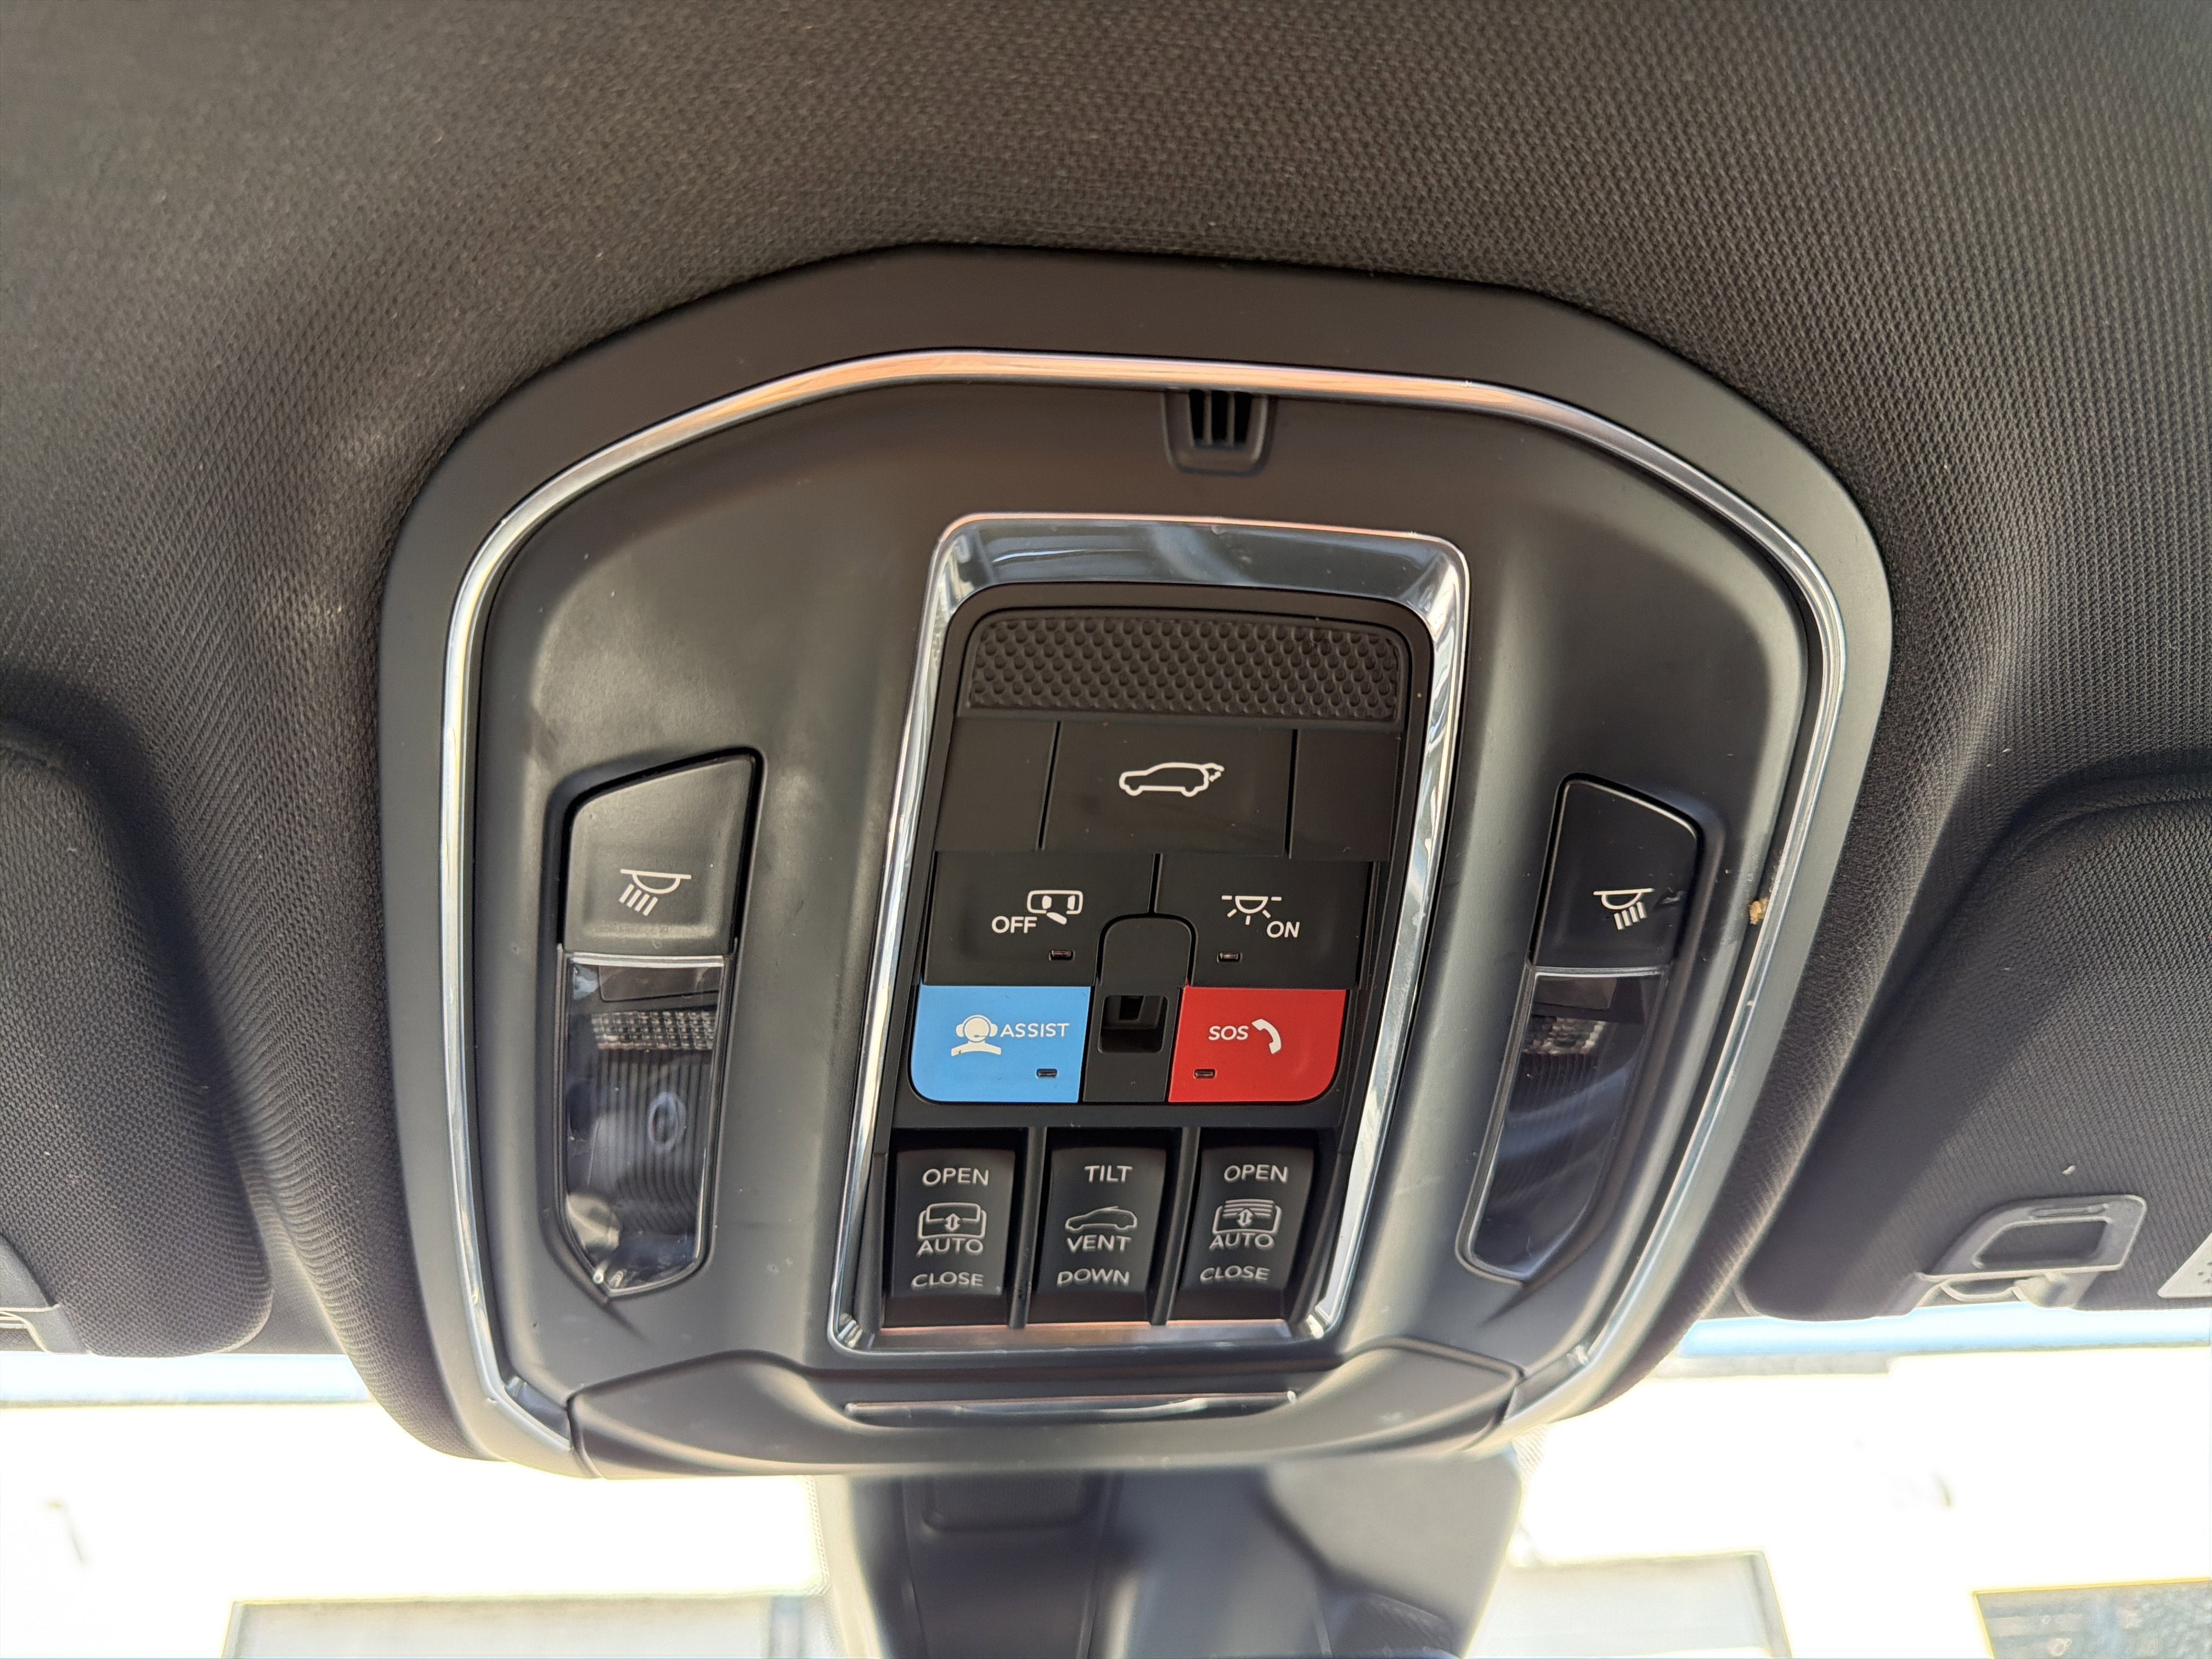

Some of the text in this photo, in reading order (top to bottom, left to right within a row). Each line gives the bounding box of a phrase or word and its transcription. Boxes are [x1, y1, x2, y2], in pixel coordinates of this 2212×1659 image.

[991, 916, 1038, 934] OFF
[1266, 921, 1301, 939] ON
[1000, 1022, 1070, 1039] ASSIST
[1207, 1024, 1249, 1041] SOS
[922, 1167, 989, 1187] OPEN
[1084, 1165, 1133, 1183] TILT
[1223, 1164, 1289, 1183] OPEN
[916, 1238, 984, 1257] AUTO
[1066, 1235, 1132, 1252] VENT
[1209, 1232, 1276, 1251] AUTO
[911, 1271, 984, 1289] CLOSE
[1057, 1268, 1130, 1286] DOWN
[1199, 1265, 1270, 1283] CLOSE
